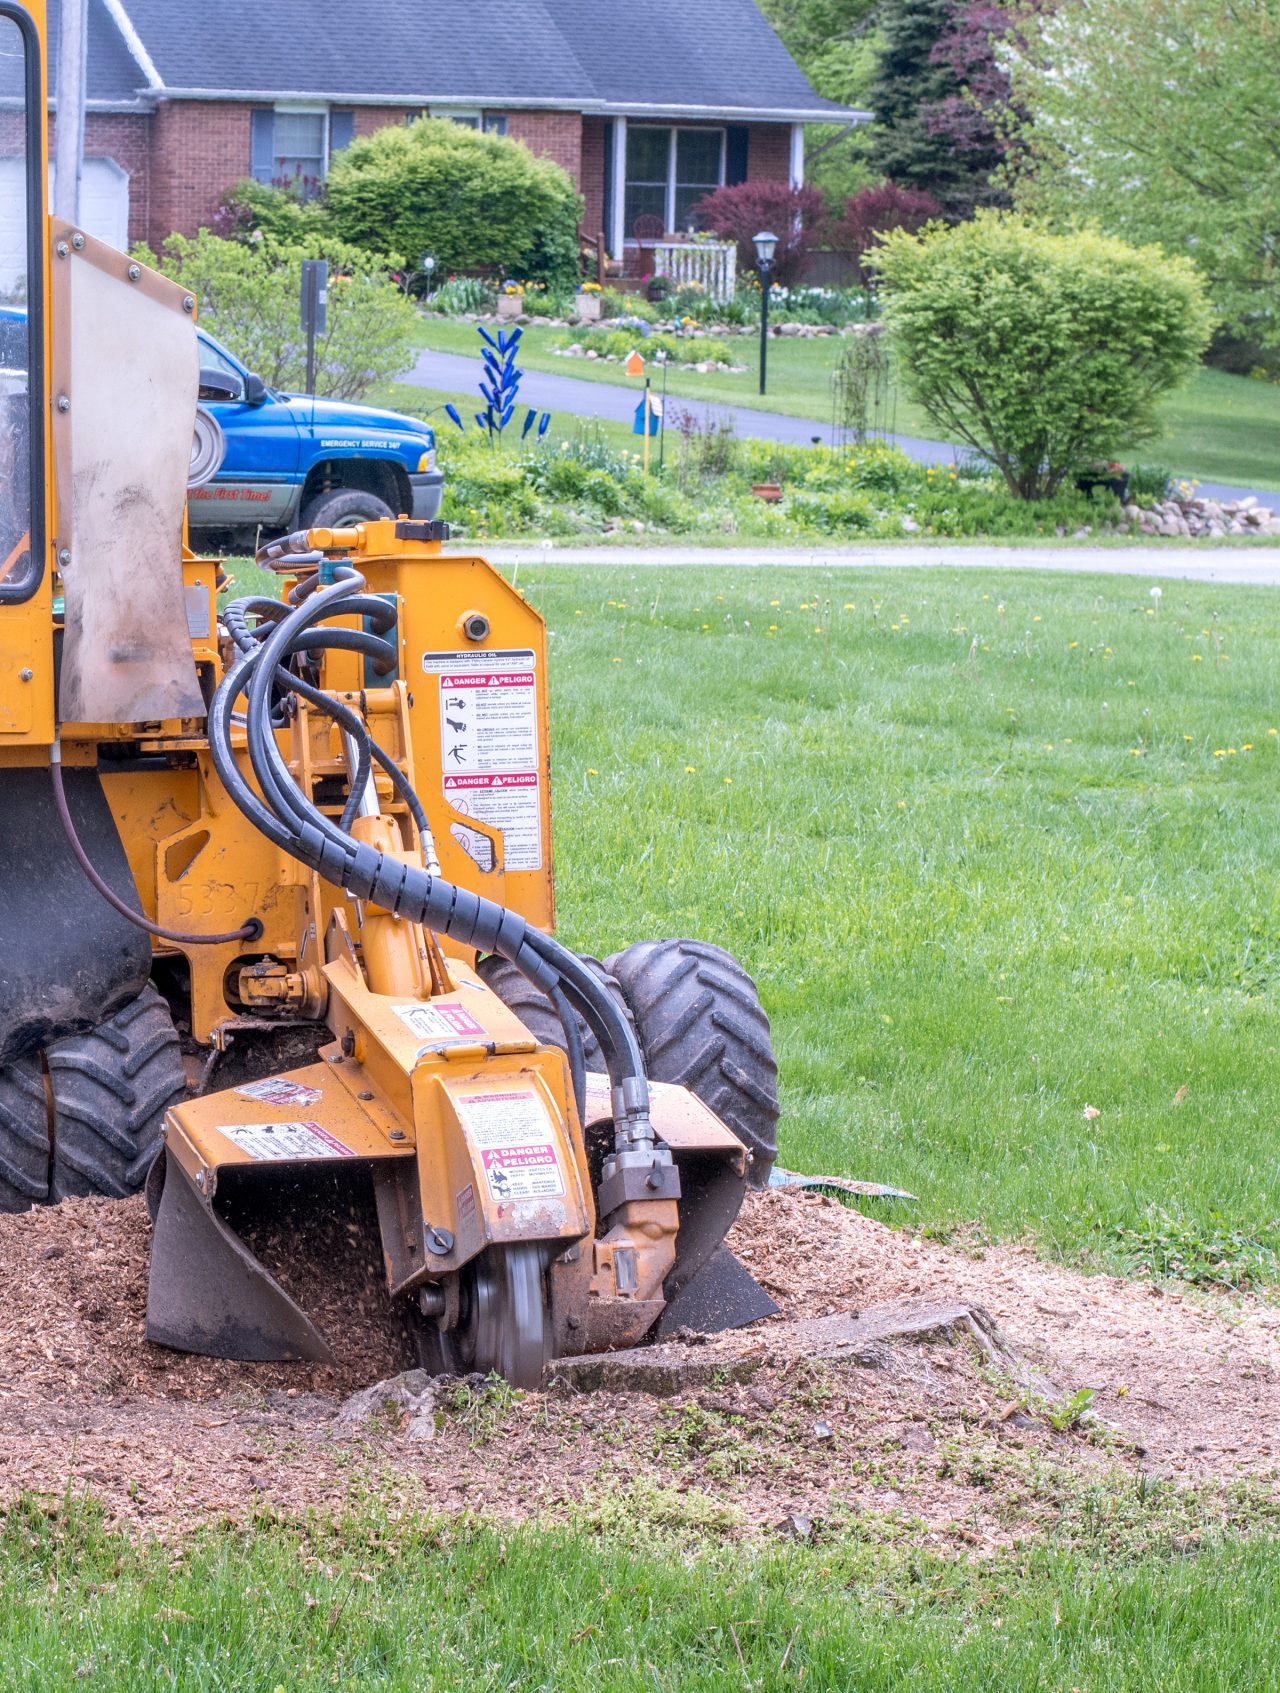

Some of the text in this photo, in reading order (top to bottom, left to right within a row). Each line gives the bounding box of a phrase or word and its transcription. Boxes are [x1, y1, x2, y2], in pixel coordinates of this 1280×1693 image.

[361, 440, 387, 448] SERVICE
[214, 487, 239, 500] First
[240, 488, 272, 501] Time!
[454, 675, 533, 685] DANGER PELIGRO
[457, 775, 536, 785] DANGER PELIGRO
[500, 1146, 549, 1157] DANGER
[502, 1155, 553, 1167] PELIGRO
